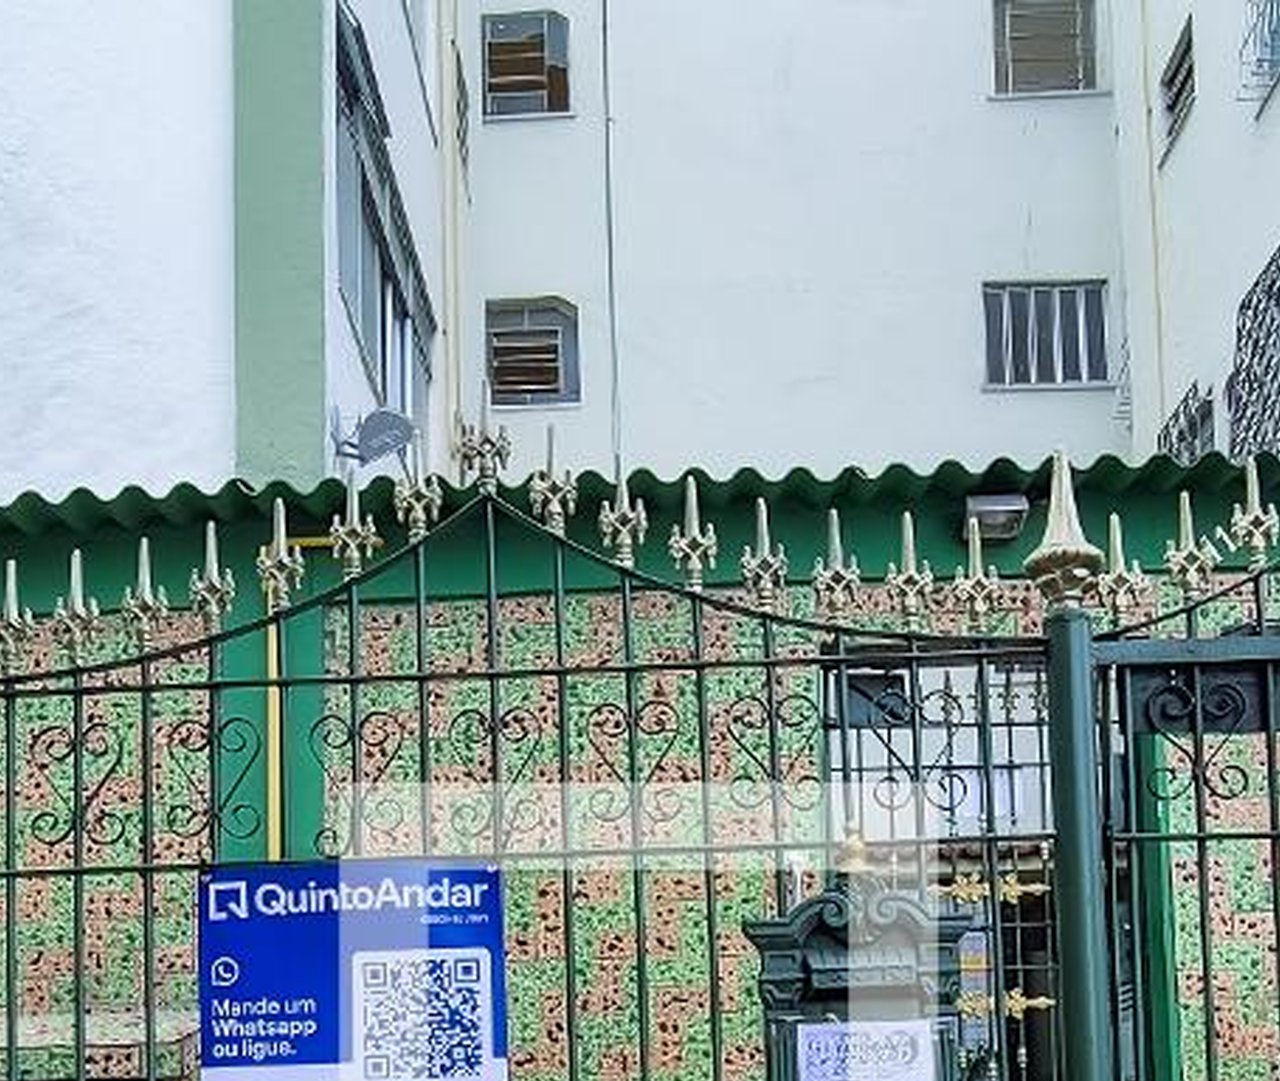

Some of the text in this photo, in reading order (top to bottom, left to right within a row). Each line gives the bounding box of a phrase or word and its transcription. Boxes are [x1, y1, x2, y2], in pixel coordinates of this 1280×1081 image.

[255, 877, 489, 916] QuintoAndar
[211, 997, 317, 1017] Mande um
[211, 1018, 318, 1039] Whatsapp
[212, 1038, 297, 1062] ou ligue.
